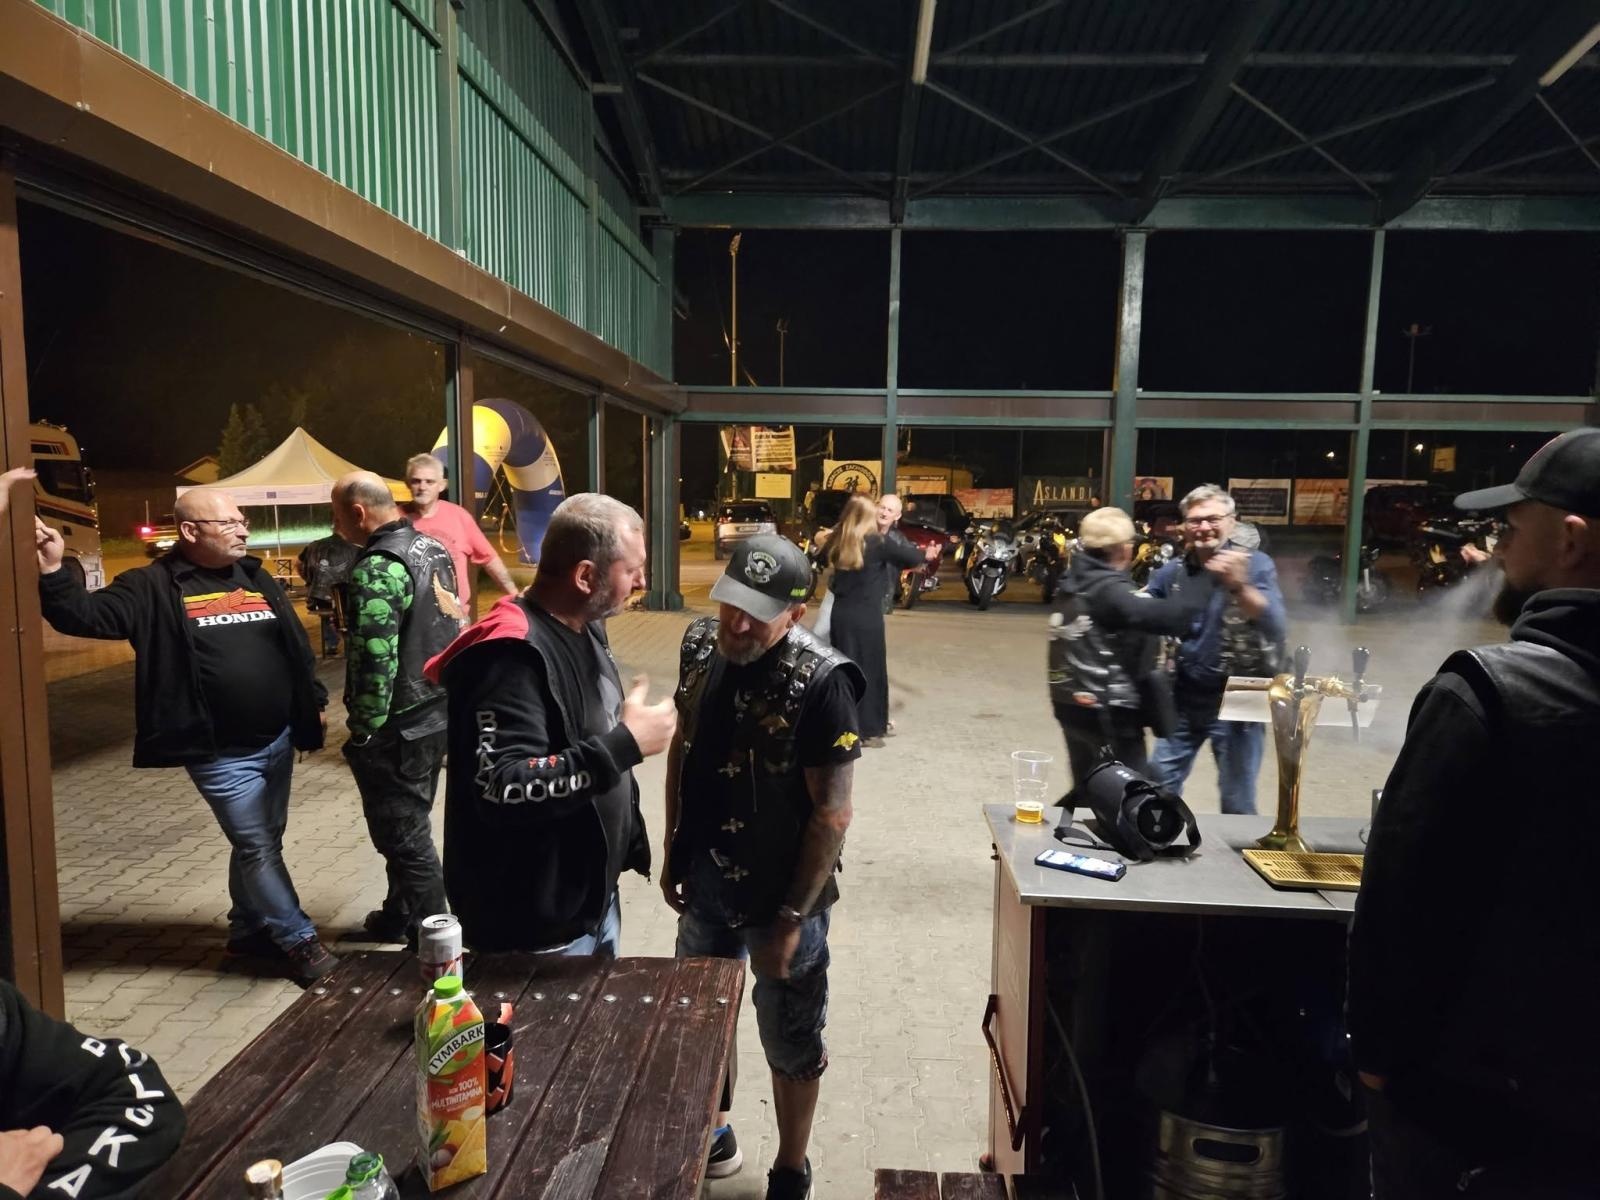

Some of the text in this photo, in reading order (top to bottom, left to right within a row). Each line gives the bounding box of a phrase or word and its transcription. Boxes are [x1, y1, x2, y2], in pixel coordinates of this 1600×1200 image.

[1033, 480, 1092, 505] ASLANDI
[196, 610, 277, 627] HONDA
[429, 1025, 484, 1070] TYMBARK
